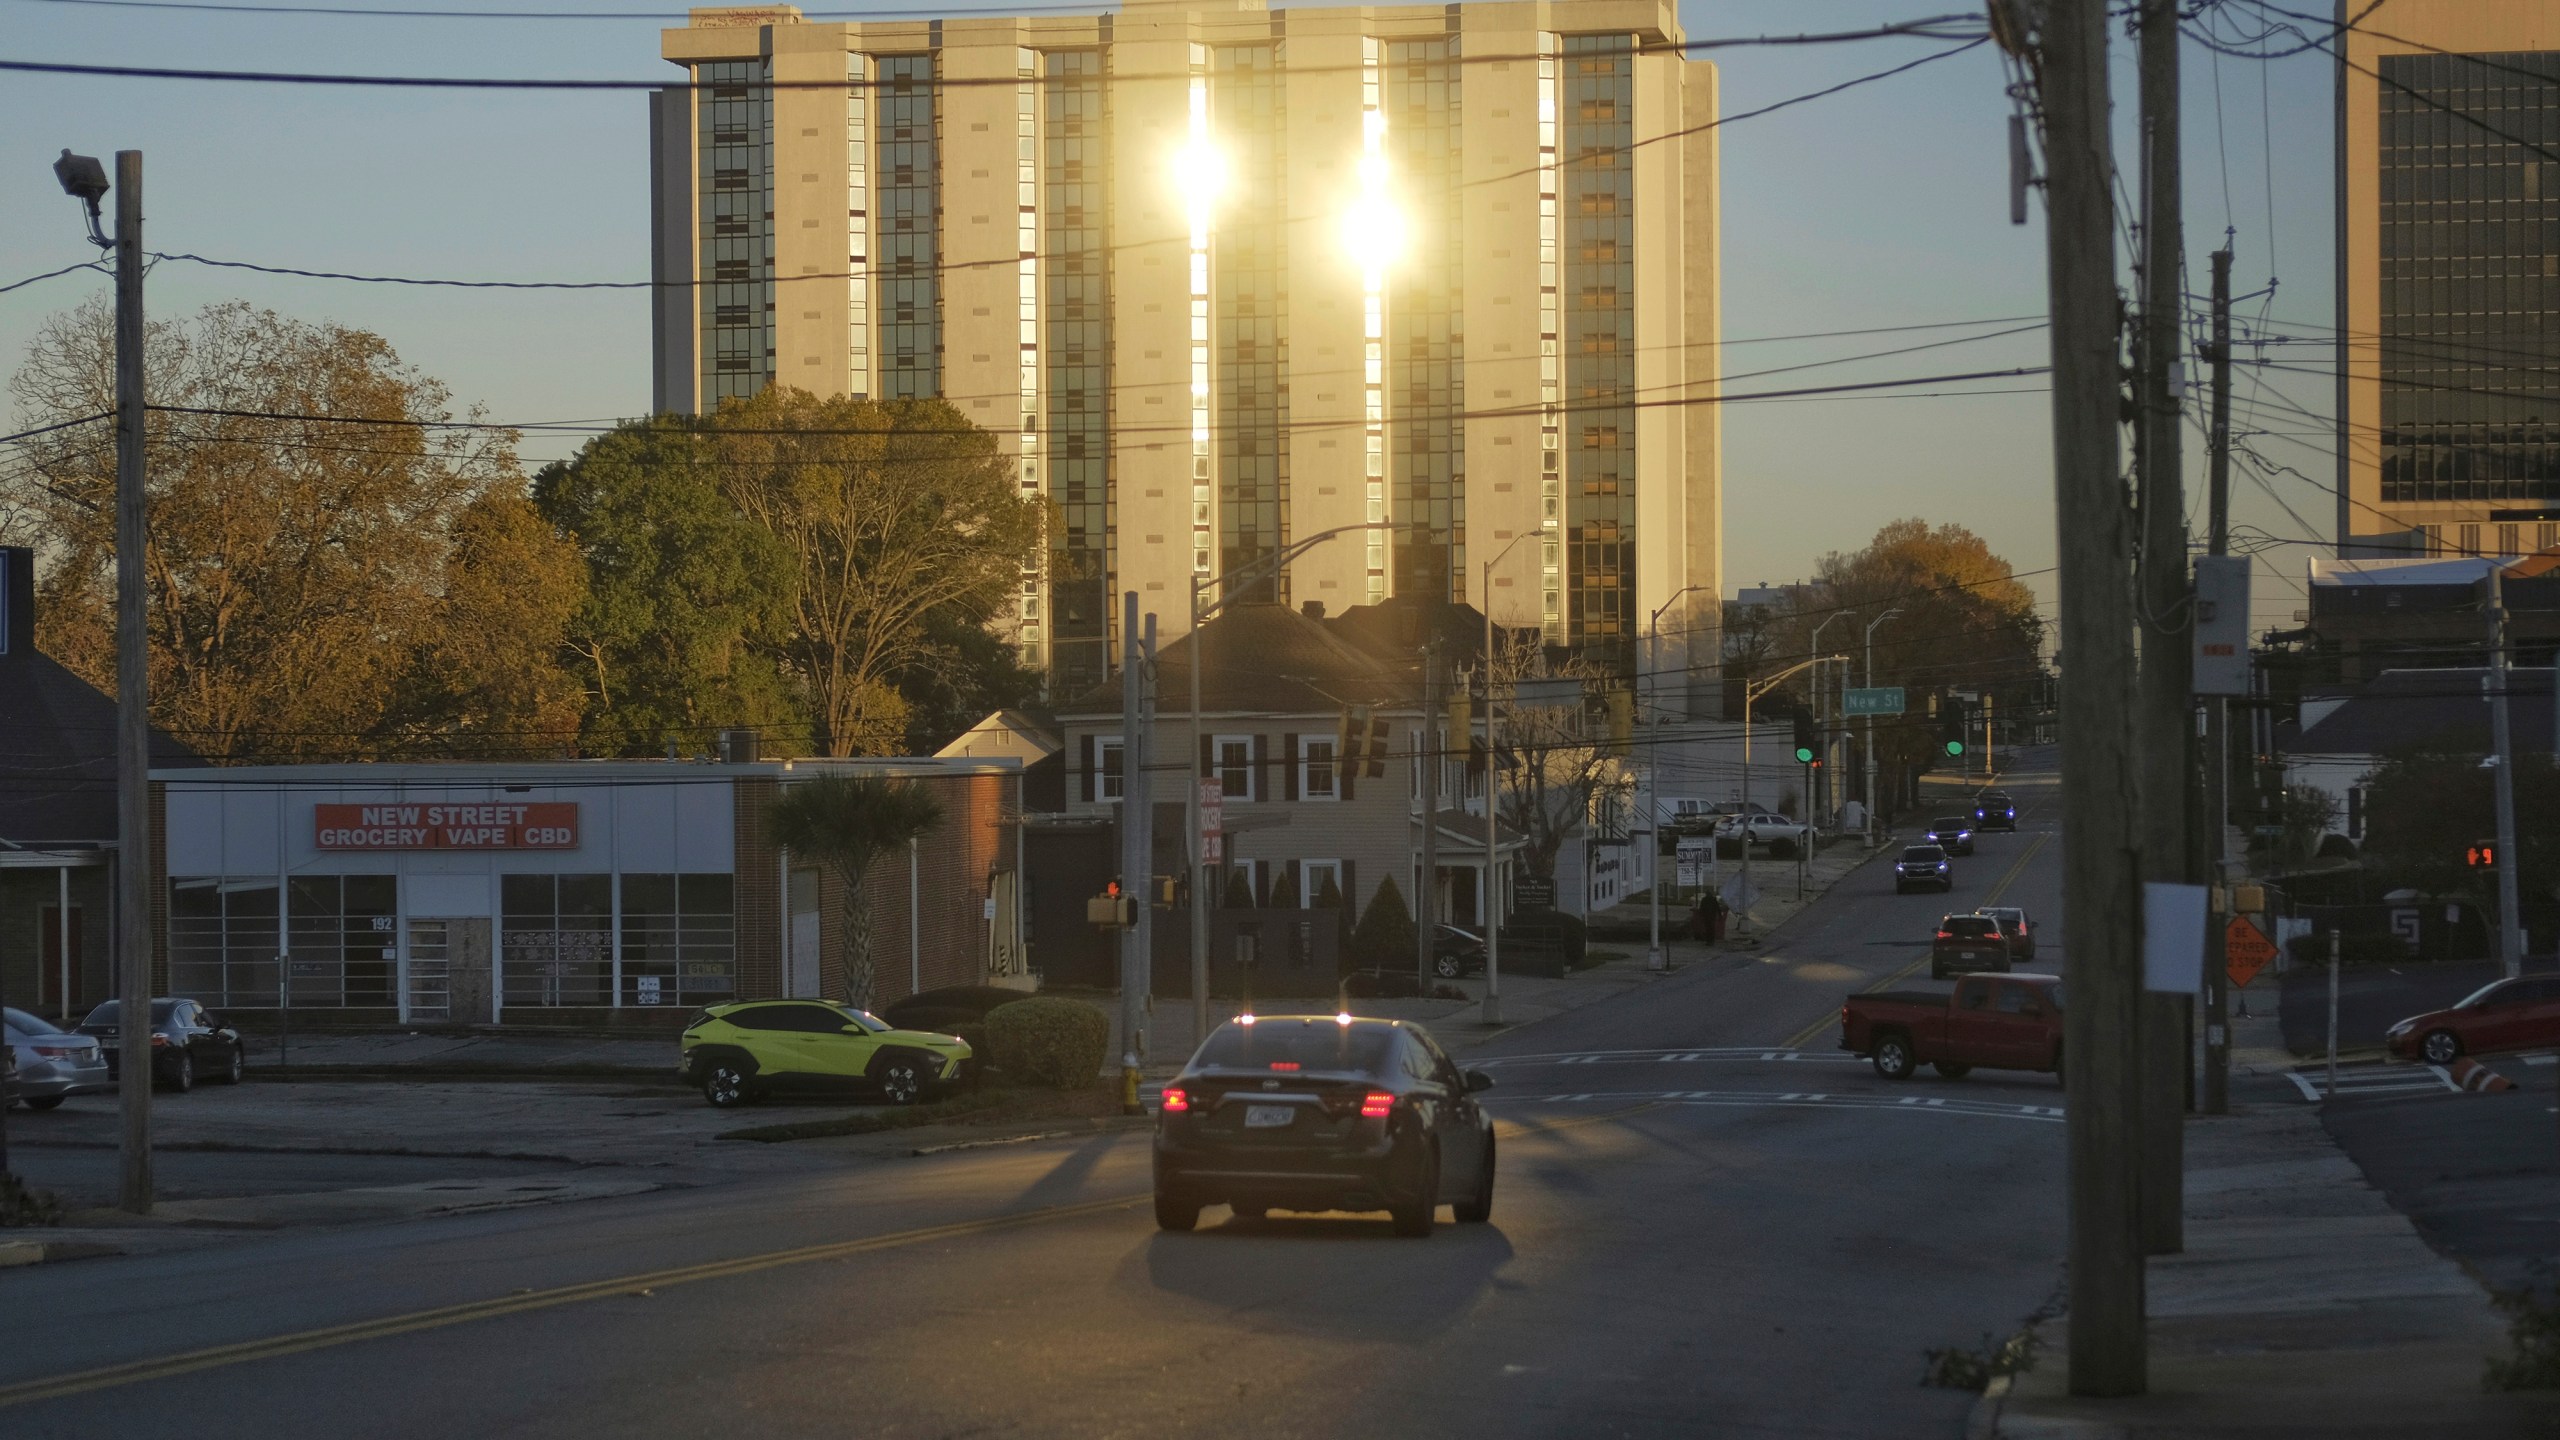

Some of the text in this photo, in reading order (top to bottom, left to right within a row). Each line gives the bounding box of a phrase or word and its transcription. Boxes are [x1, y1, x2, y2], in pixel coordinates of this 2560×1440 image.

[1848, 694, 1899, 708] New St
[362, 806, 528, 826] NEW STREET
[1201, 806, 1221, 831] ROCERY
[319, 827, 572, 846] GROCERY VAPE CBD
[371, 917, 393, 930] 192
[2234, 927, 2248, 938] BE
[2228, 942, 2269, 953] EPARED
[2238, 957, 2264, 968] STOP
